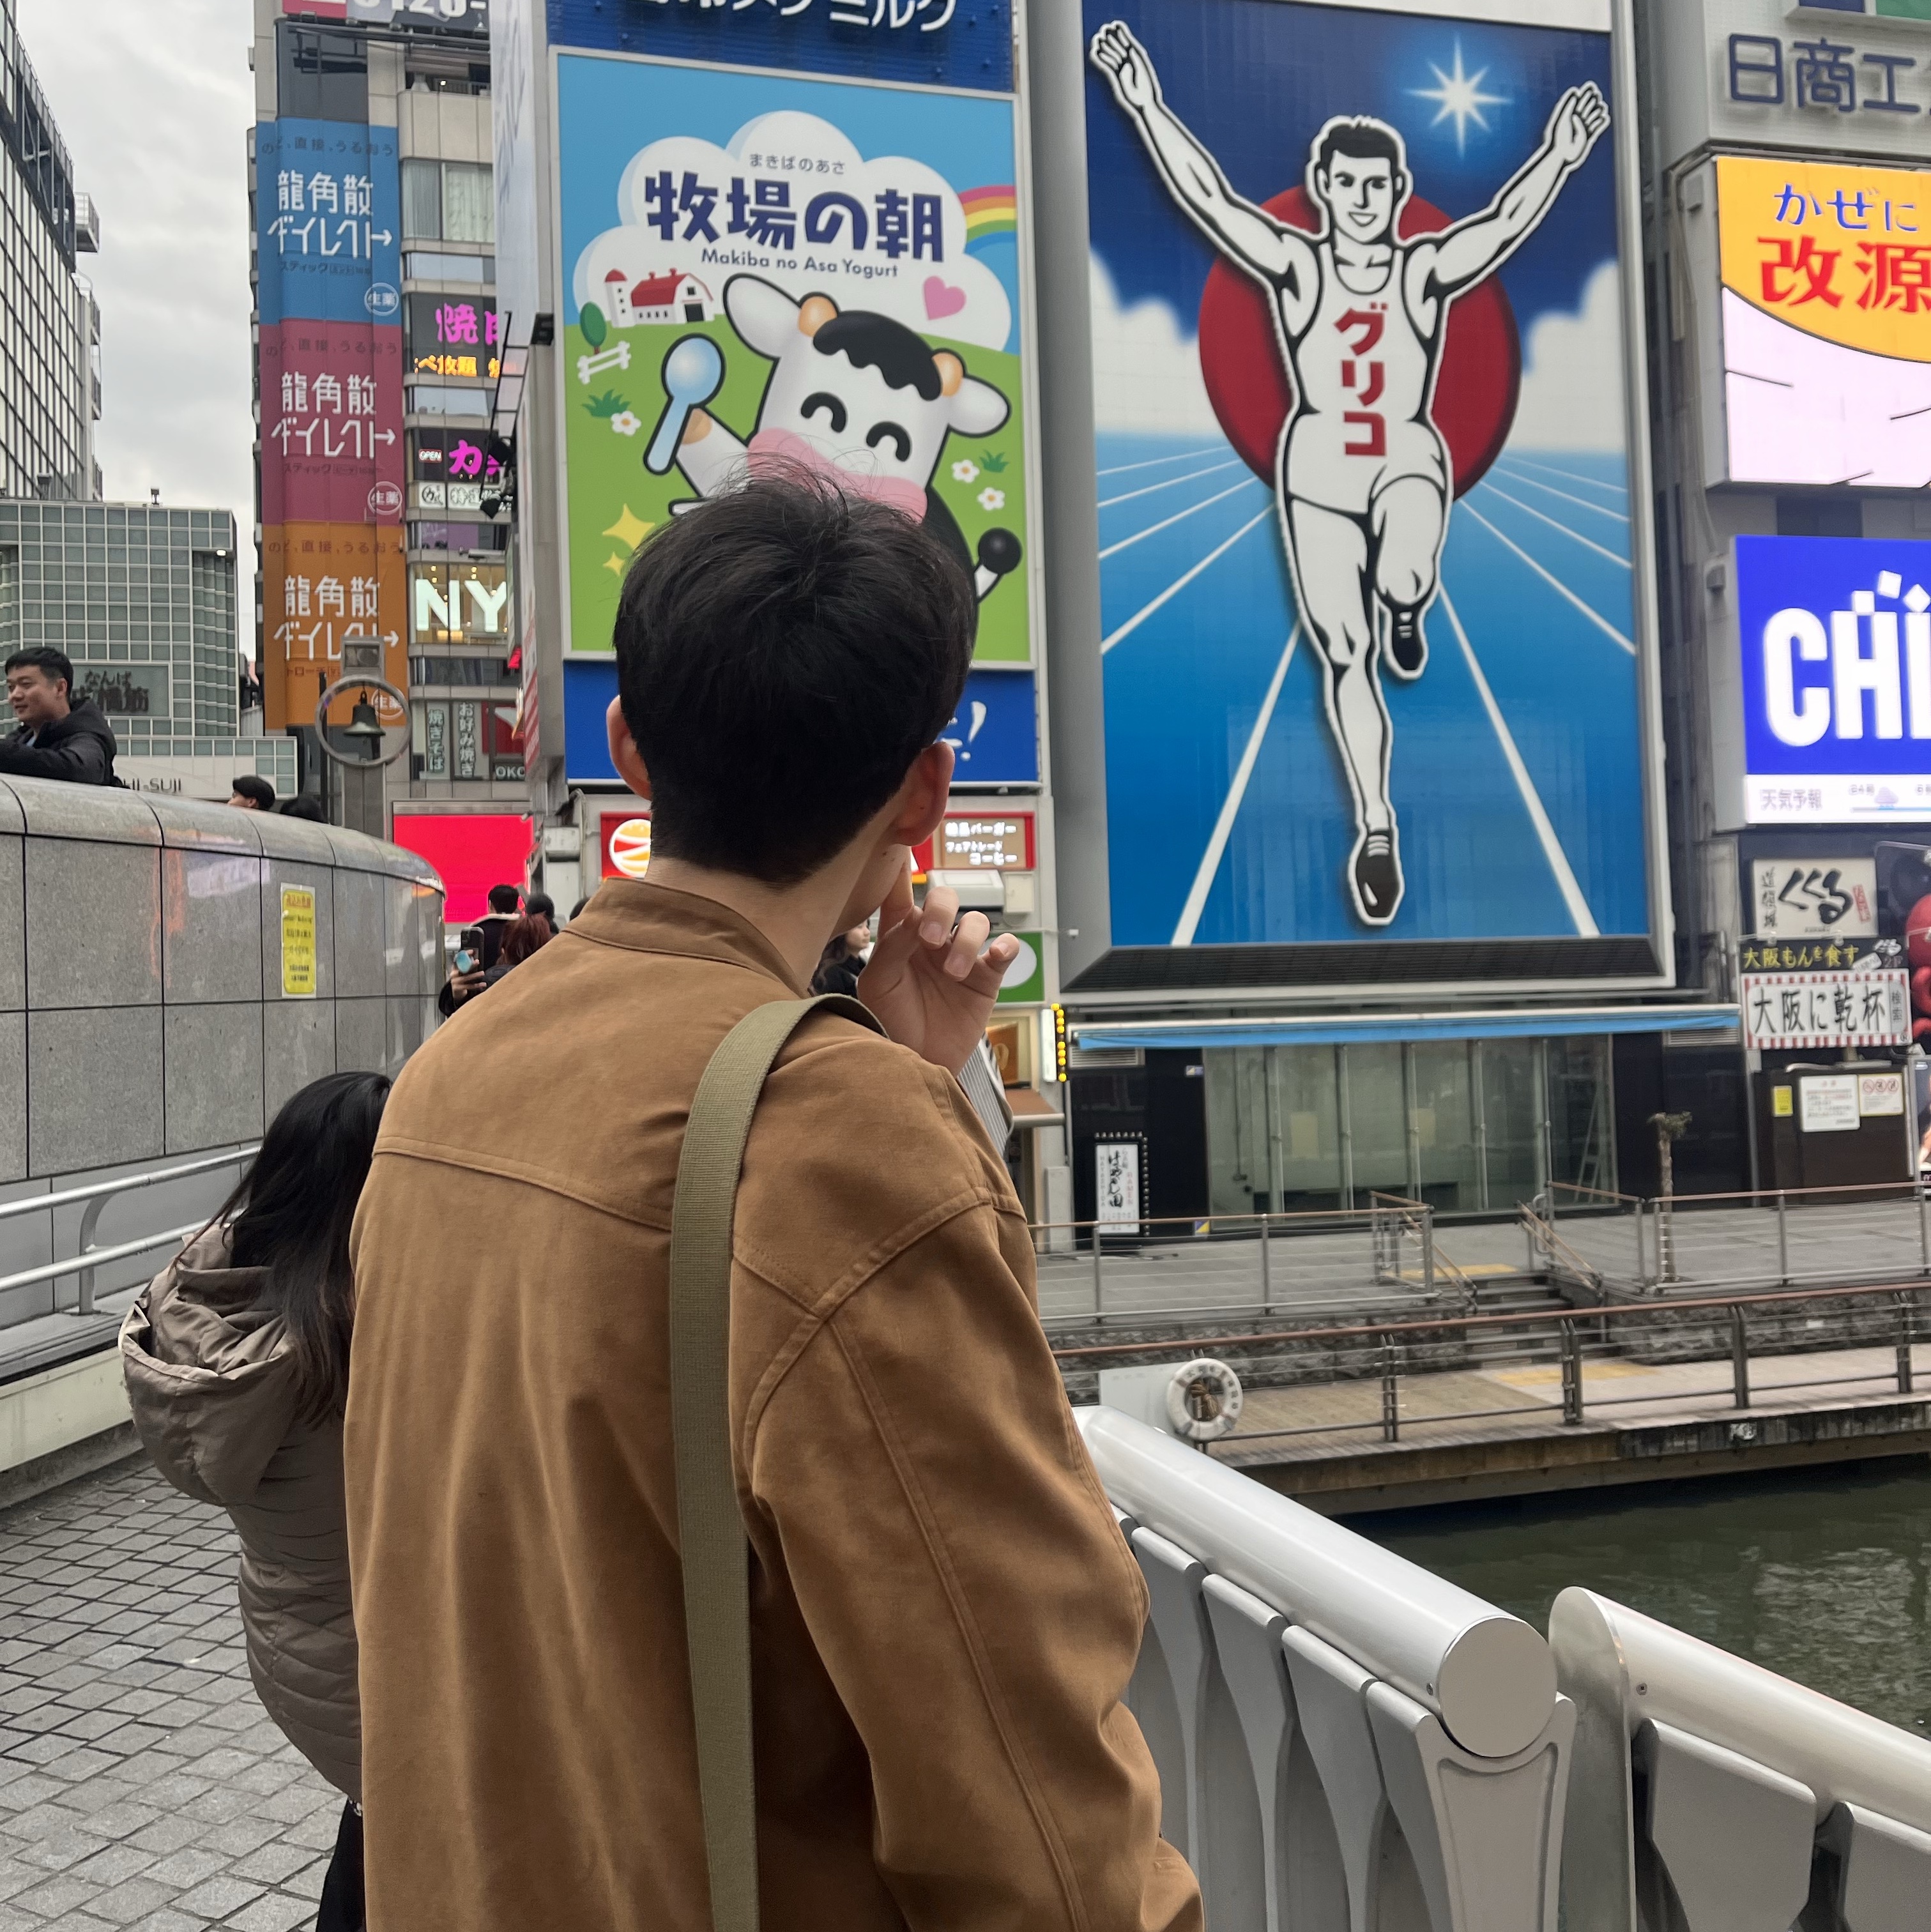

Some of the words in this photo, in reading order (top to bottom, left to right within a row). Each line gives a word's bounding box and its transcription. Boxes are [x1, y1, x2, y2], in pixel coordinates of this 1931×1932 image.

[1729, 33, 1931, 113] 日商工
[749, 153, 846, 174] まきばのあさ
[278, 170, 373, 216] 龍角散
[645, 170, 944, 262] 牧場の朝
[1774, 183, 1919, 232] かぜに
[267, 215, 390, 259] ダイレクト
[702, 248, 770, 268] Makiba
[777, 259, 797, 270] no
[805, 257, 838, 273] Asa
[842, 259, 899, 278] Yogurt
[1757, 234, 1931, 314] 改源
[282, 371, 377, 415] 龍角散
[1334, 301, 1388, 456] グリコ
[271, 418, 394, 459] ダイレクト
[420, 451, 441, 460] OPEN
[285, 575, 380, 618] 龍角散
[416, 579, 507, 632] NY
[428, 709, 445, 773] 焼きそば
[459, 702, 475, 777] お好み焼き
[1760, 788, 1822, 811] 天気予報
[1753, 982, 1886, 1034] 大阪に乾杯
